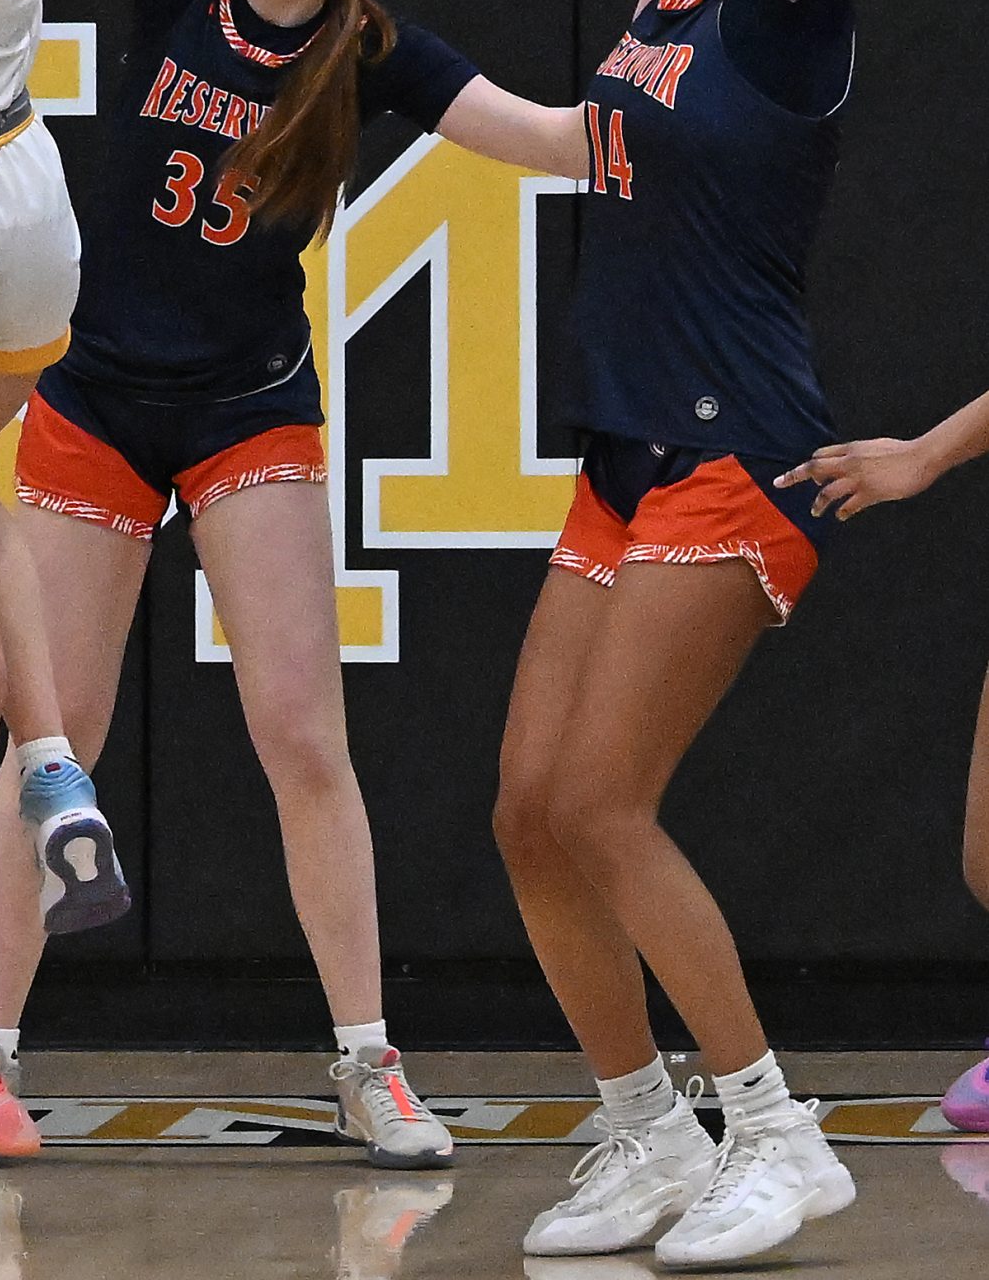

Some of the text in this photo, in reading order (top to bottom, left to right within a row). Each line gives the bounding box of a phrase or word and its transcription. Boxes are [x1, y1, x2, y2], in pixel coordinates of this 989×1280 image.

[139, 56, 274, 140] RESERV
[152, 149, 262, 246] 35
[587, 100, 633, 201] 14
